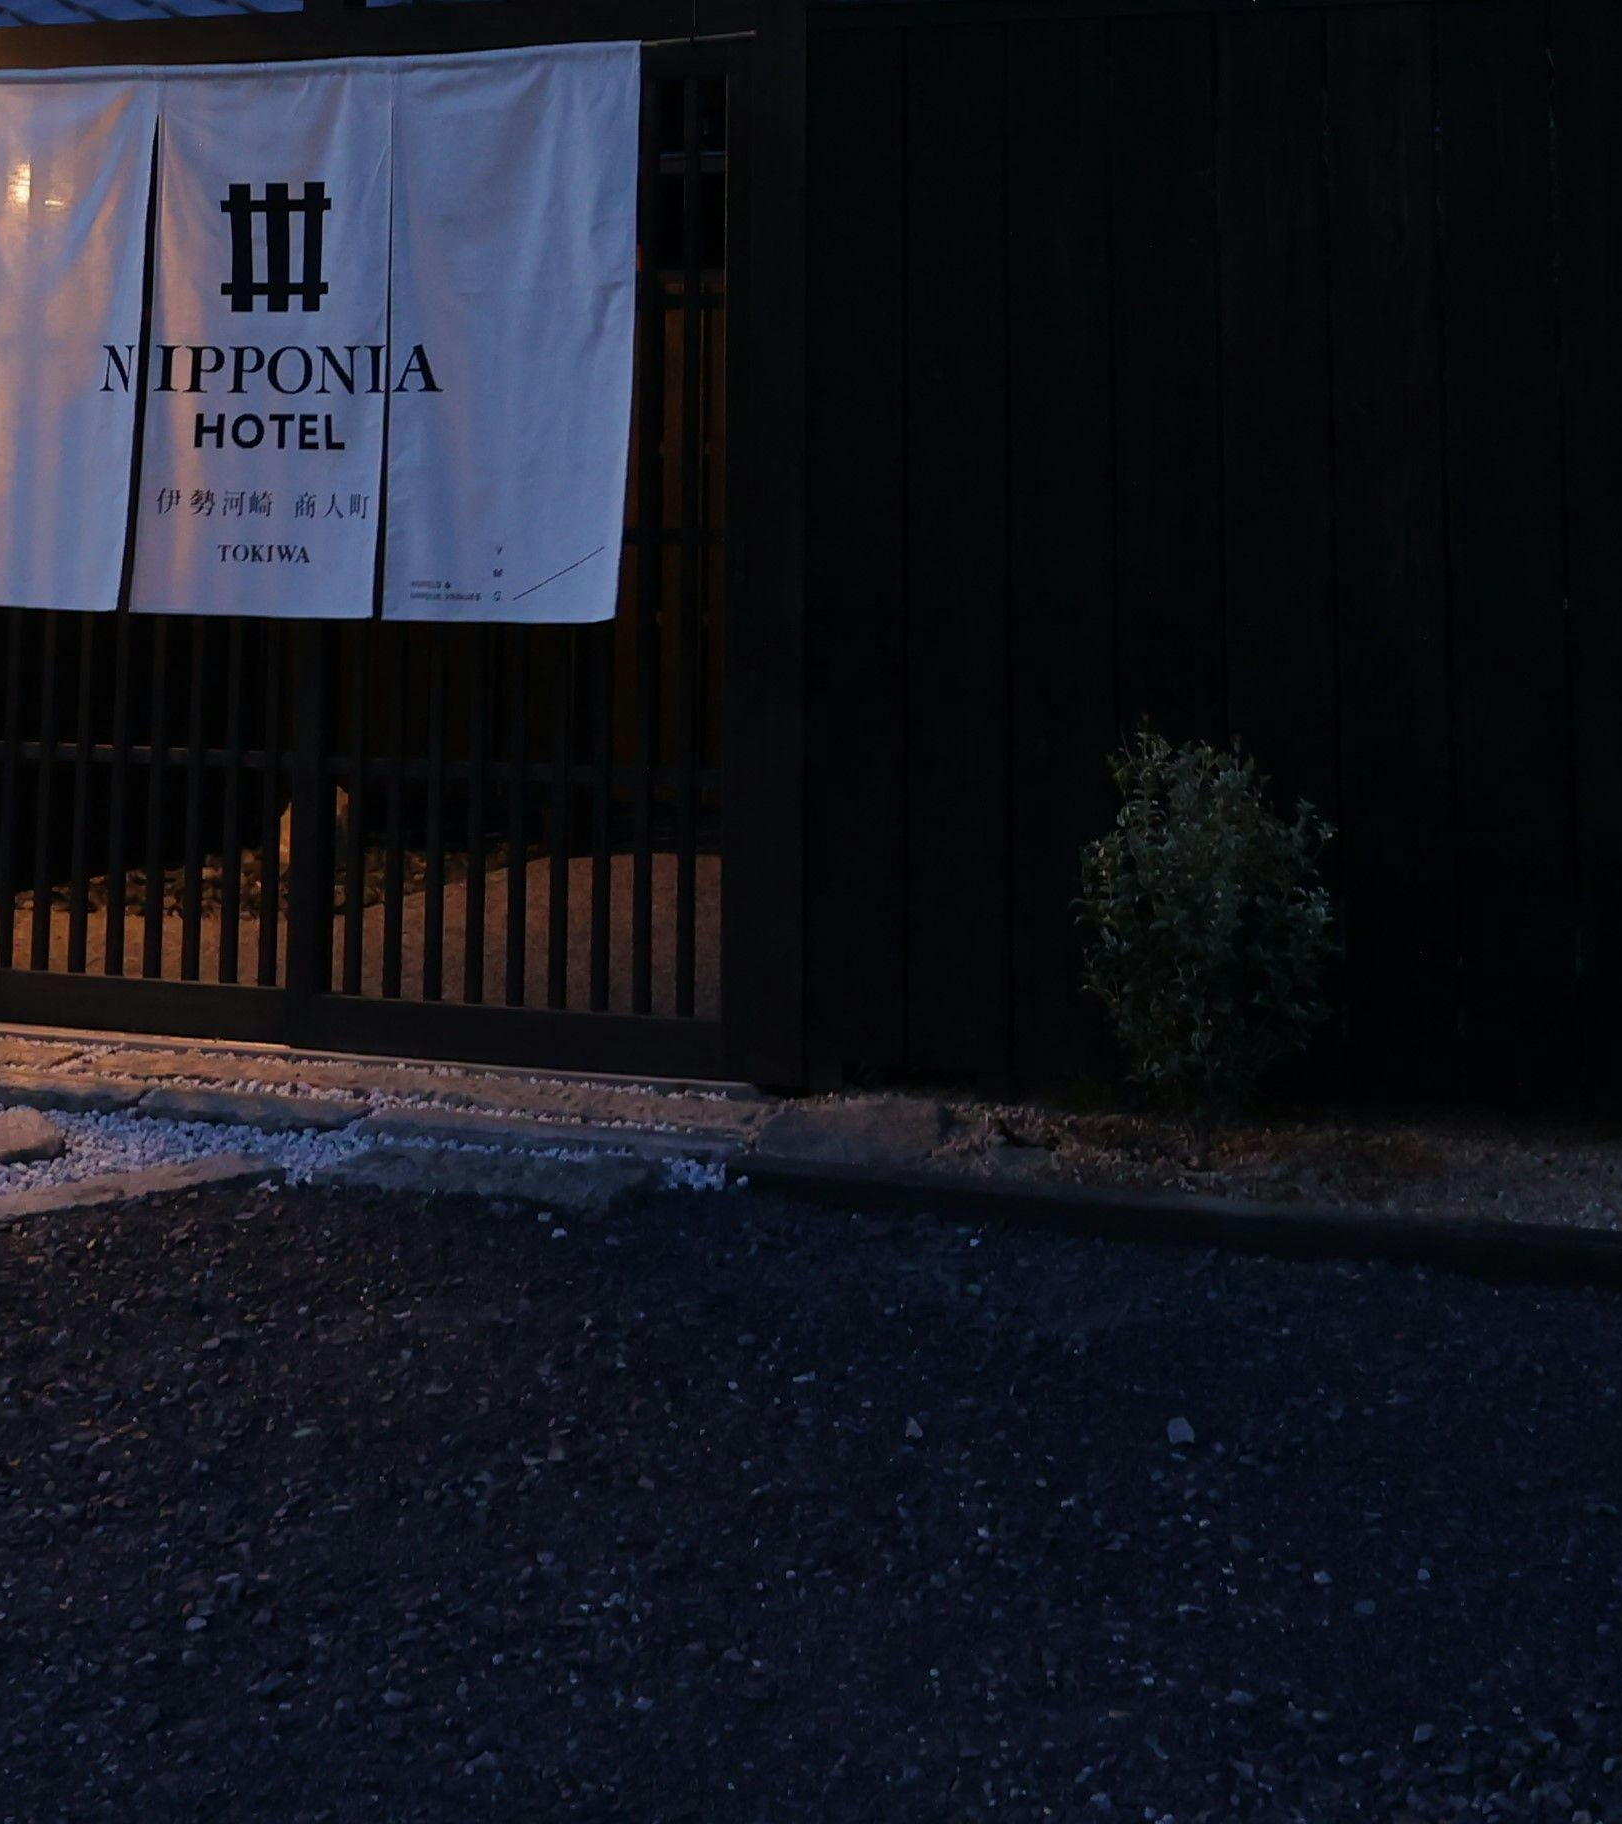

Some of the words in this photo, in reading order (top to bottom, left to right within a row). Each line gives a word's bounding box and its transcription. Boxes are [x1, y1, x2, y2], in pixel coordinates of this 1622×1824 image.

[99, 344, 443, 395] NIPPONIA
[194, 413, 345, 450] HOTEL
[217, 544, 310, 564] TOKIWA
